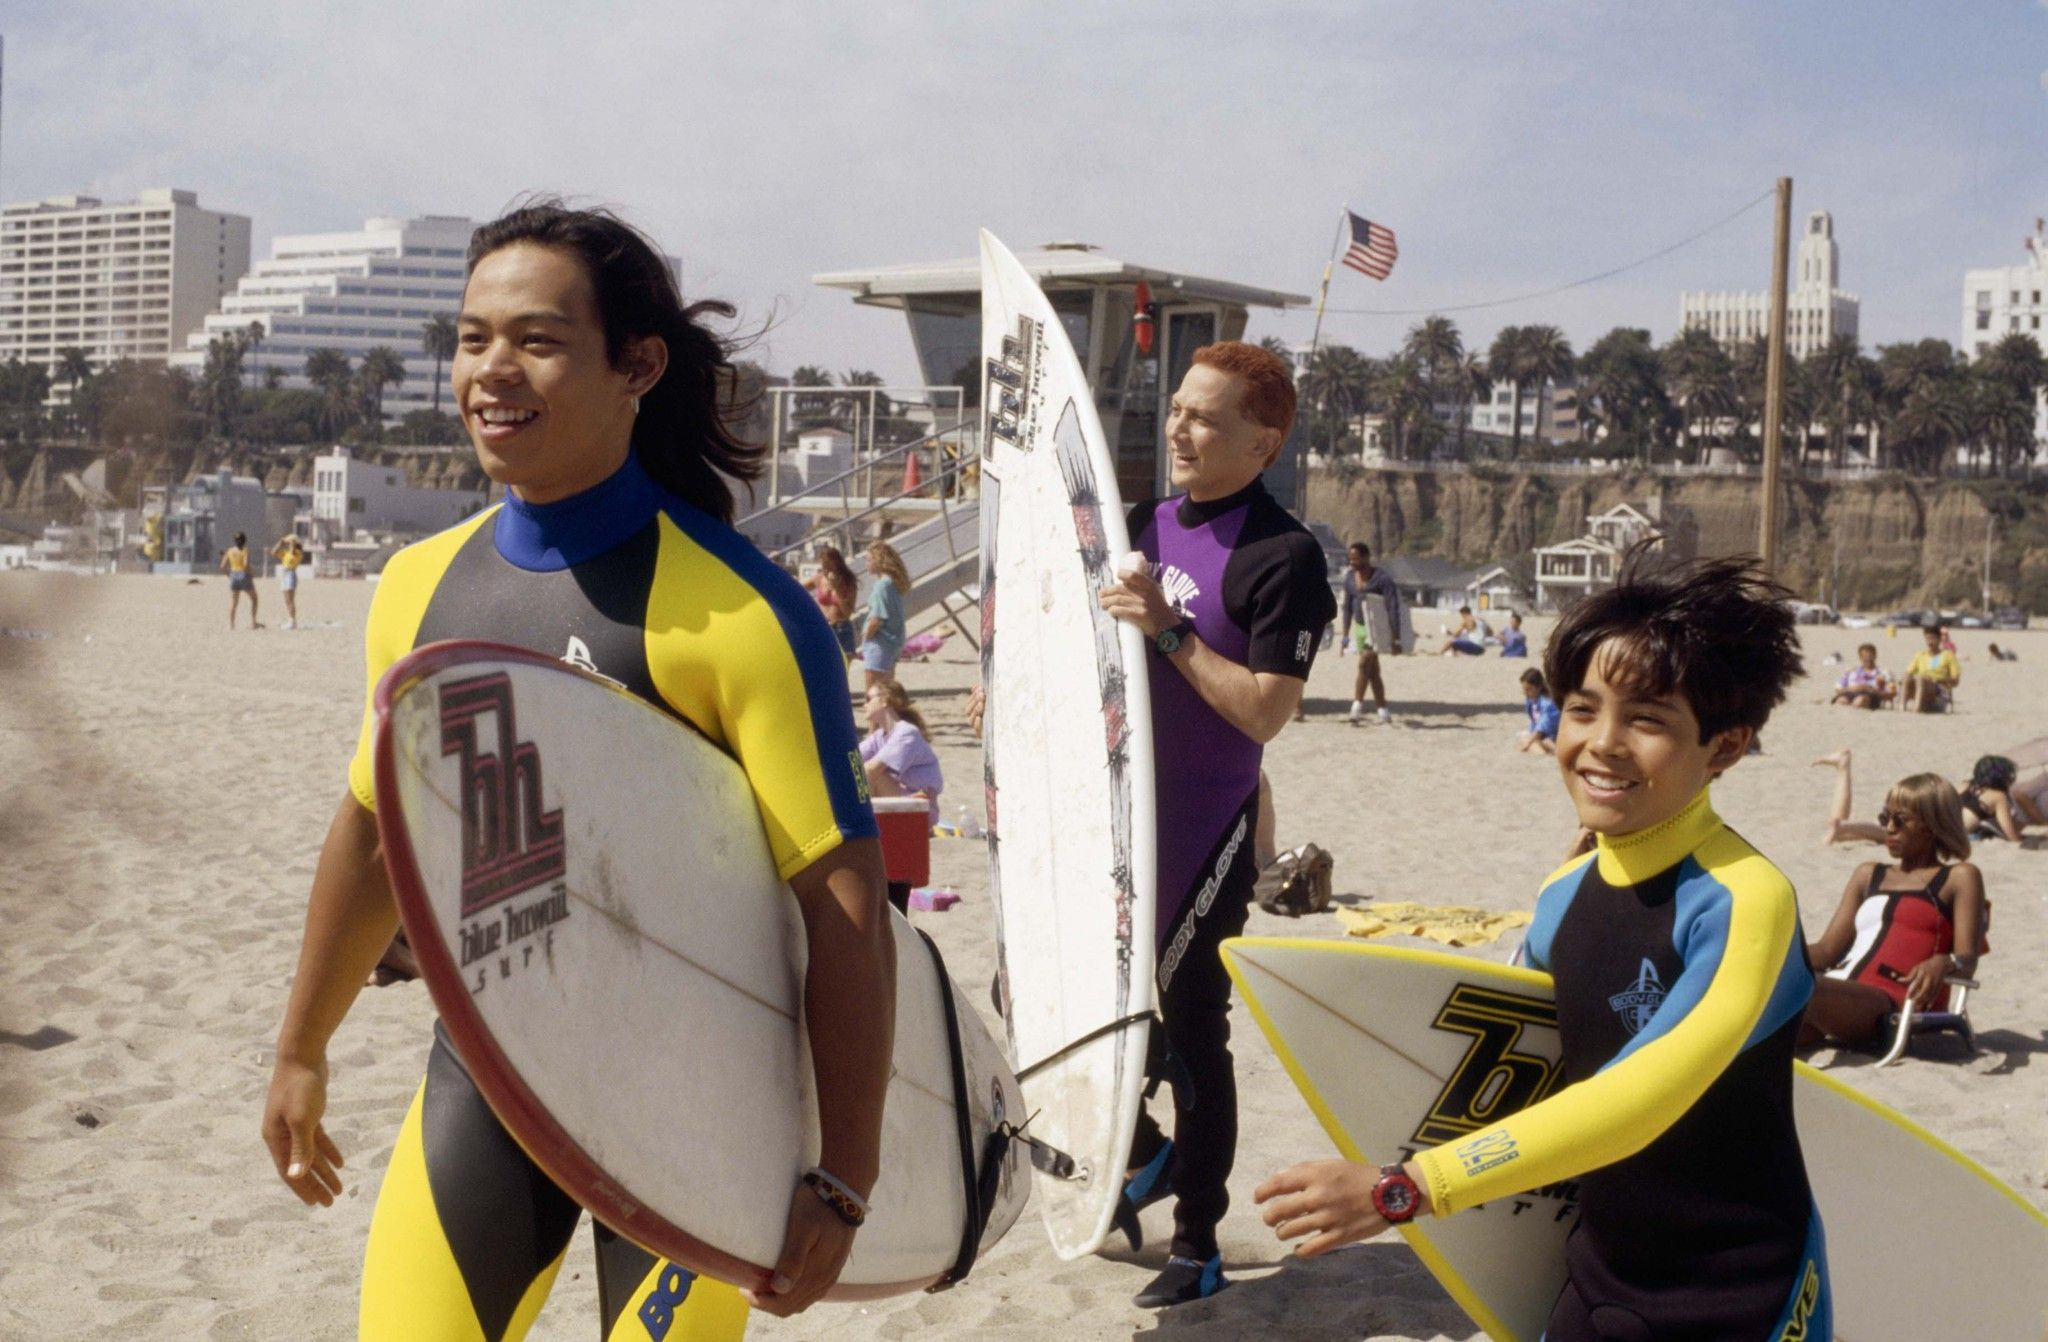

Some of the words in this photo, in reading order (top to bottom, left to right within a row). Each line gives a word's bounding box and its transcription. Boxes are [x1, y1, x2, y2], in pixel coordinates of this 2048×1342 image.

[1162, 564, 1200, 604] GLOVE
[1158, 907, 1196, 993] BODY
[1194, 813, 1248, 918] GLOVE
[637, 1262, 699, 1342] BO
